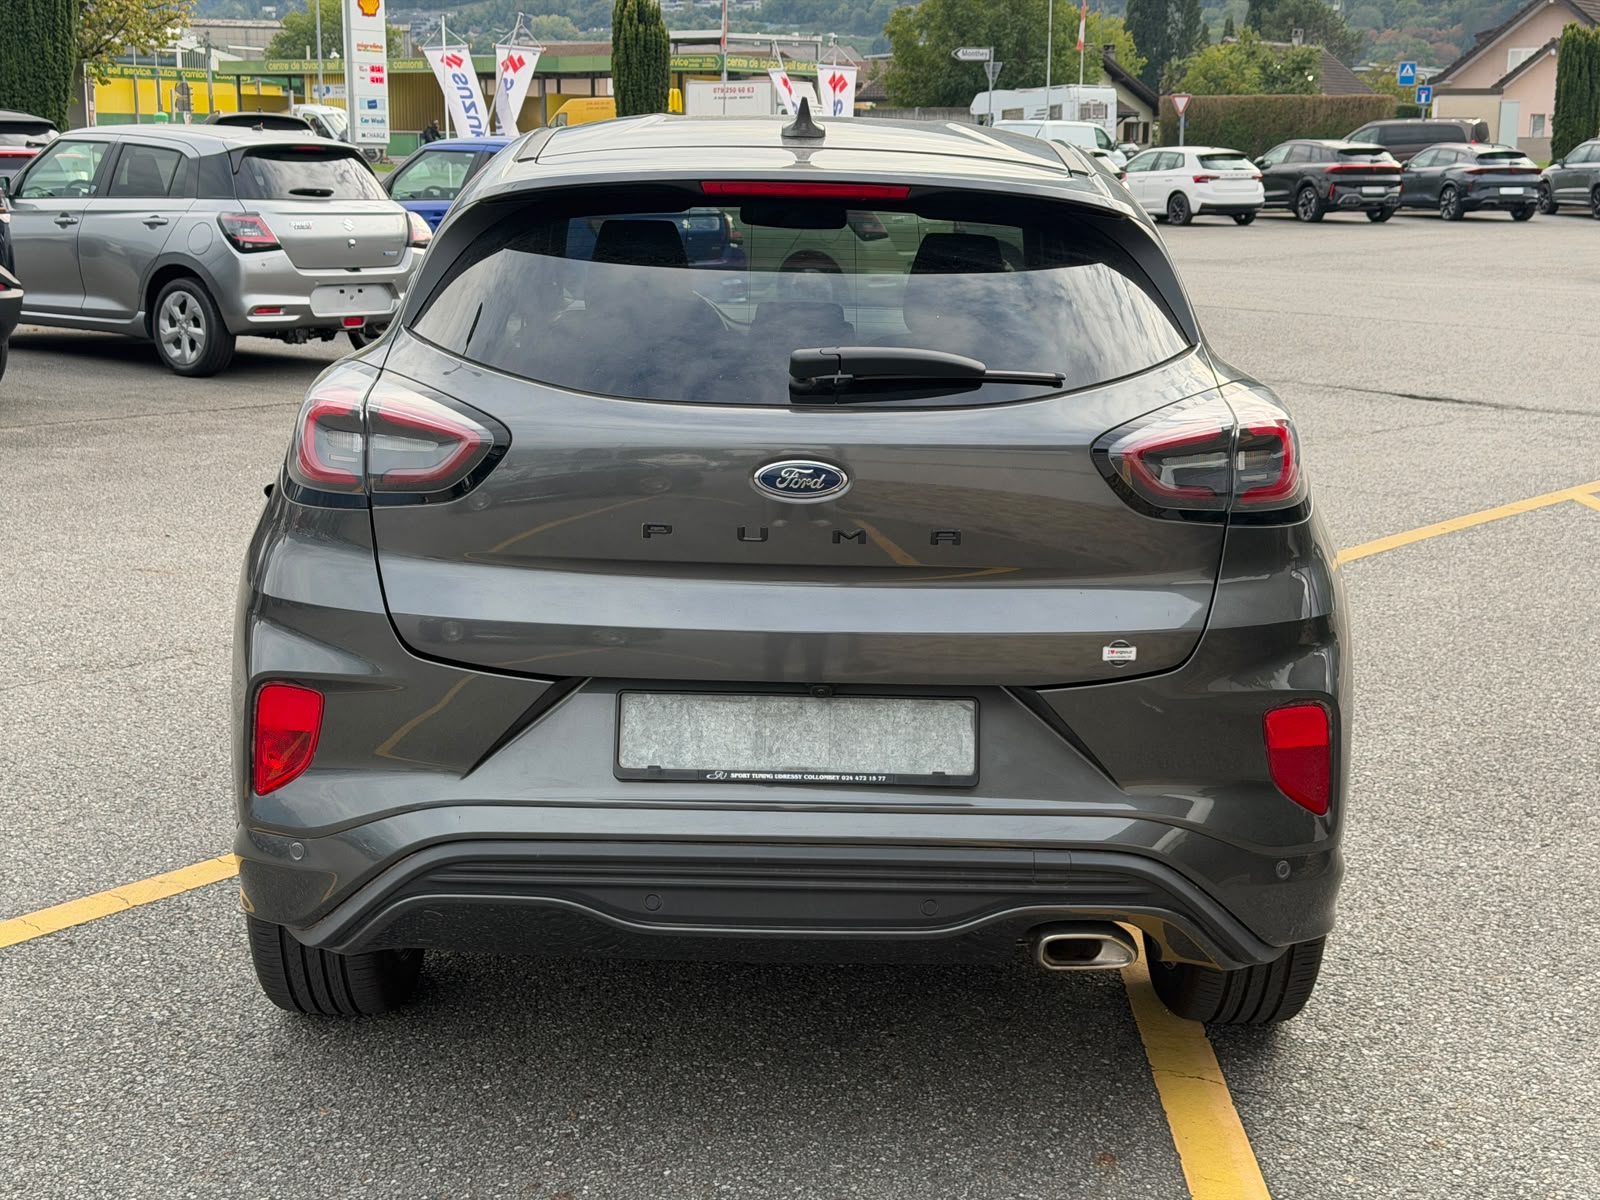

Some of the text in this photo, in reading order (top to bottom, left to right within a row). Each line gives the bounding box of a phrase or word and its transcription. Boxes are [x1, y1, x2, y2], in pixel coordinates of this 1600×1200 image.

[727, 58, 748, 67] centre
[749, 57, 759, 68] de
[776, 468, 826, 489] Ford
[642, 523, 961, 545] PUMA
